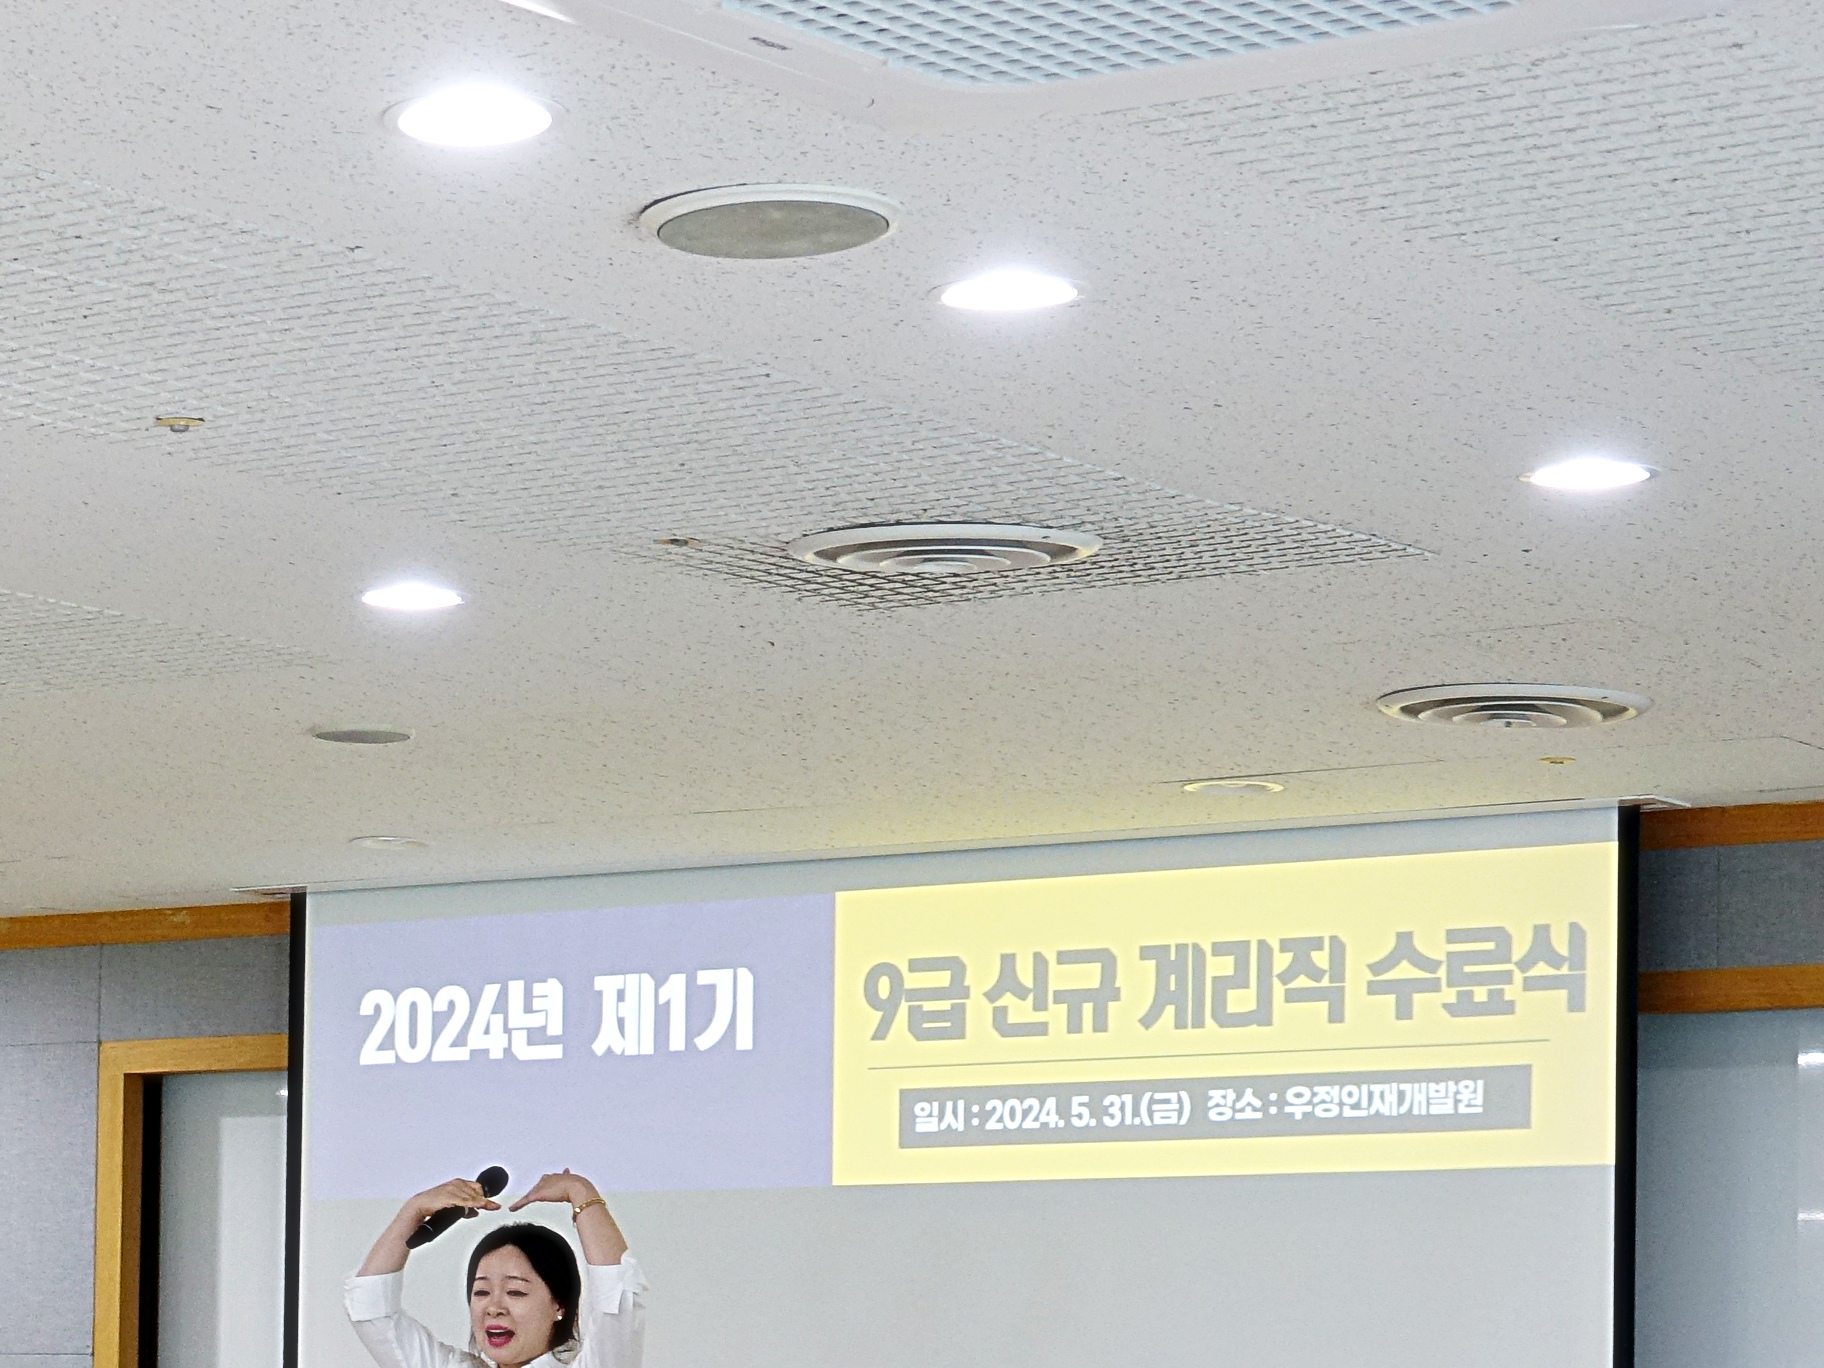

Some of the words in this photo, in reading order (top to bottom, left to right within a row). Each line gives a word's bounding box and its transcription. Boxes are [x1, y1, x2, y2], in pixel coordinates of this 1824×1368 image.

[359, 977, 564, 1066] 2024년
[591, 967, 755, 1058] 제1기
[863, 955, 970, 1042] 9급
[983, 947, 1120, 1038] 신규
[1138, 935, 1347, 1032] 계리직
[1366, 921, 1588, 1021] 수료식
[1284, 1079, 1485, 1120] 우정인재개발원
